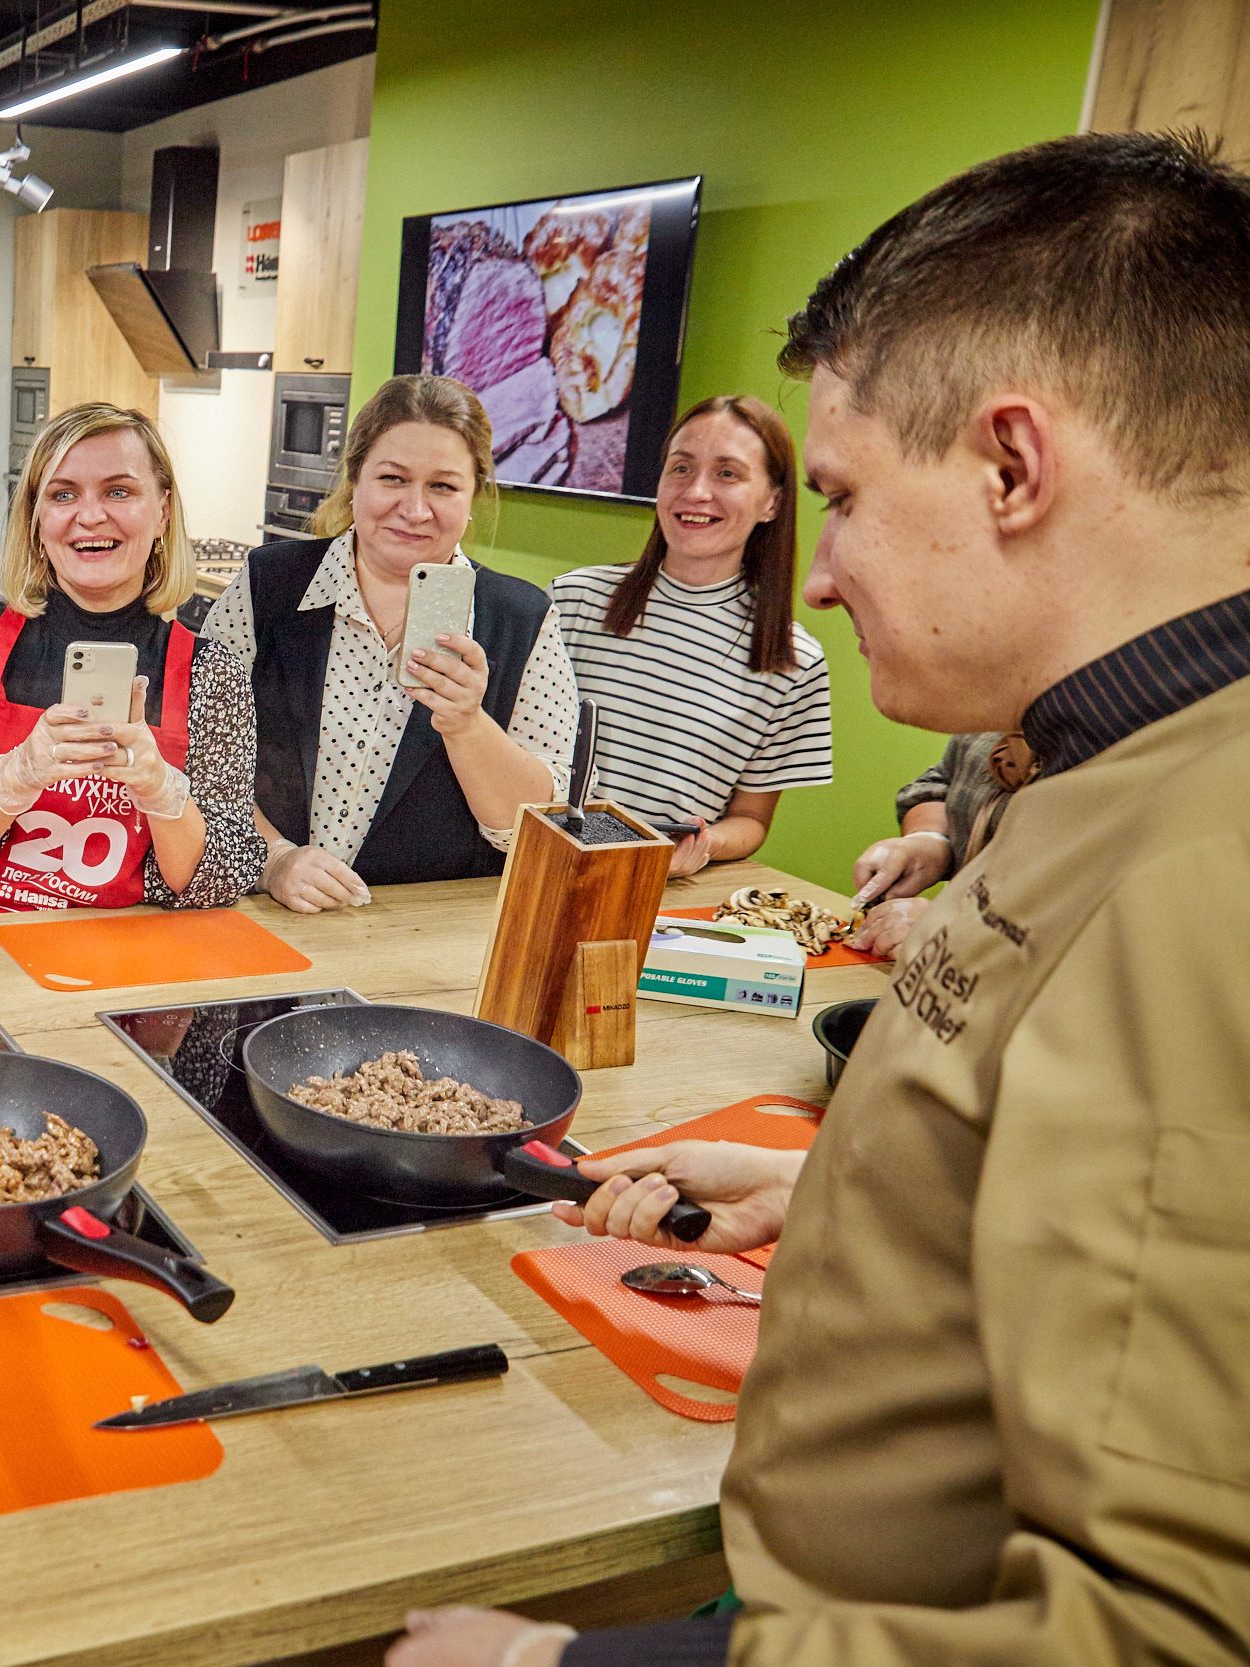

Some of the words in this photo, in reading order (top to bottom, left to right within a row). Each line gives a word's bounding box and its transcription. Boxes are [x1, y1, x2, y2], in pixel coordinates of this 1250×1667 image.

[87, 797, 132, 817] уже
[8, 810, 128, 886] 20
[1, 866, 31, 882] лет
[13, 889, 69, 909] Hansa
[640, 972, 675, 983] POSABLE
[676, 977, 708, 987] GLOVES
